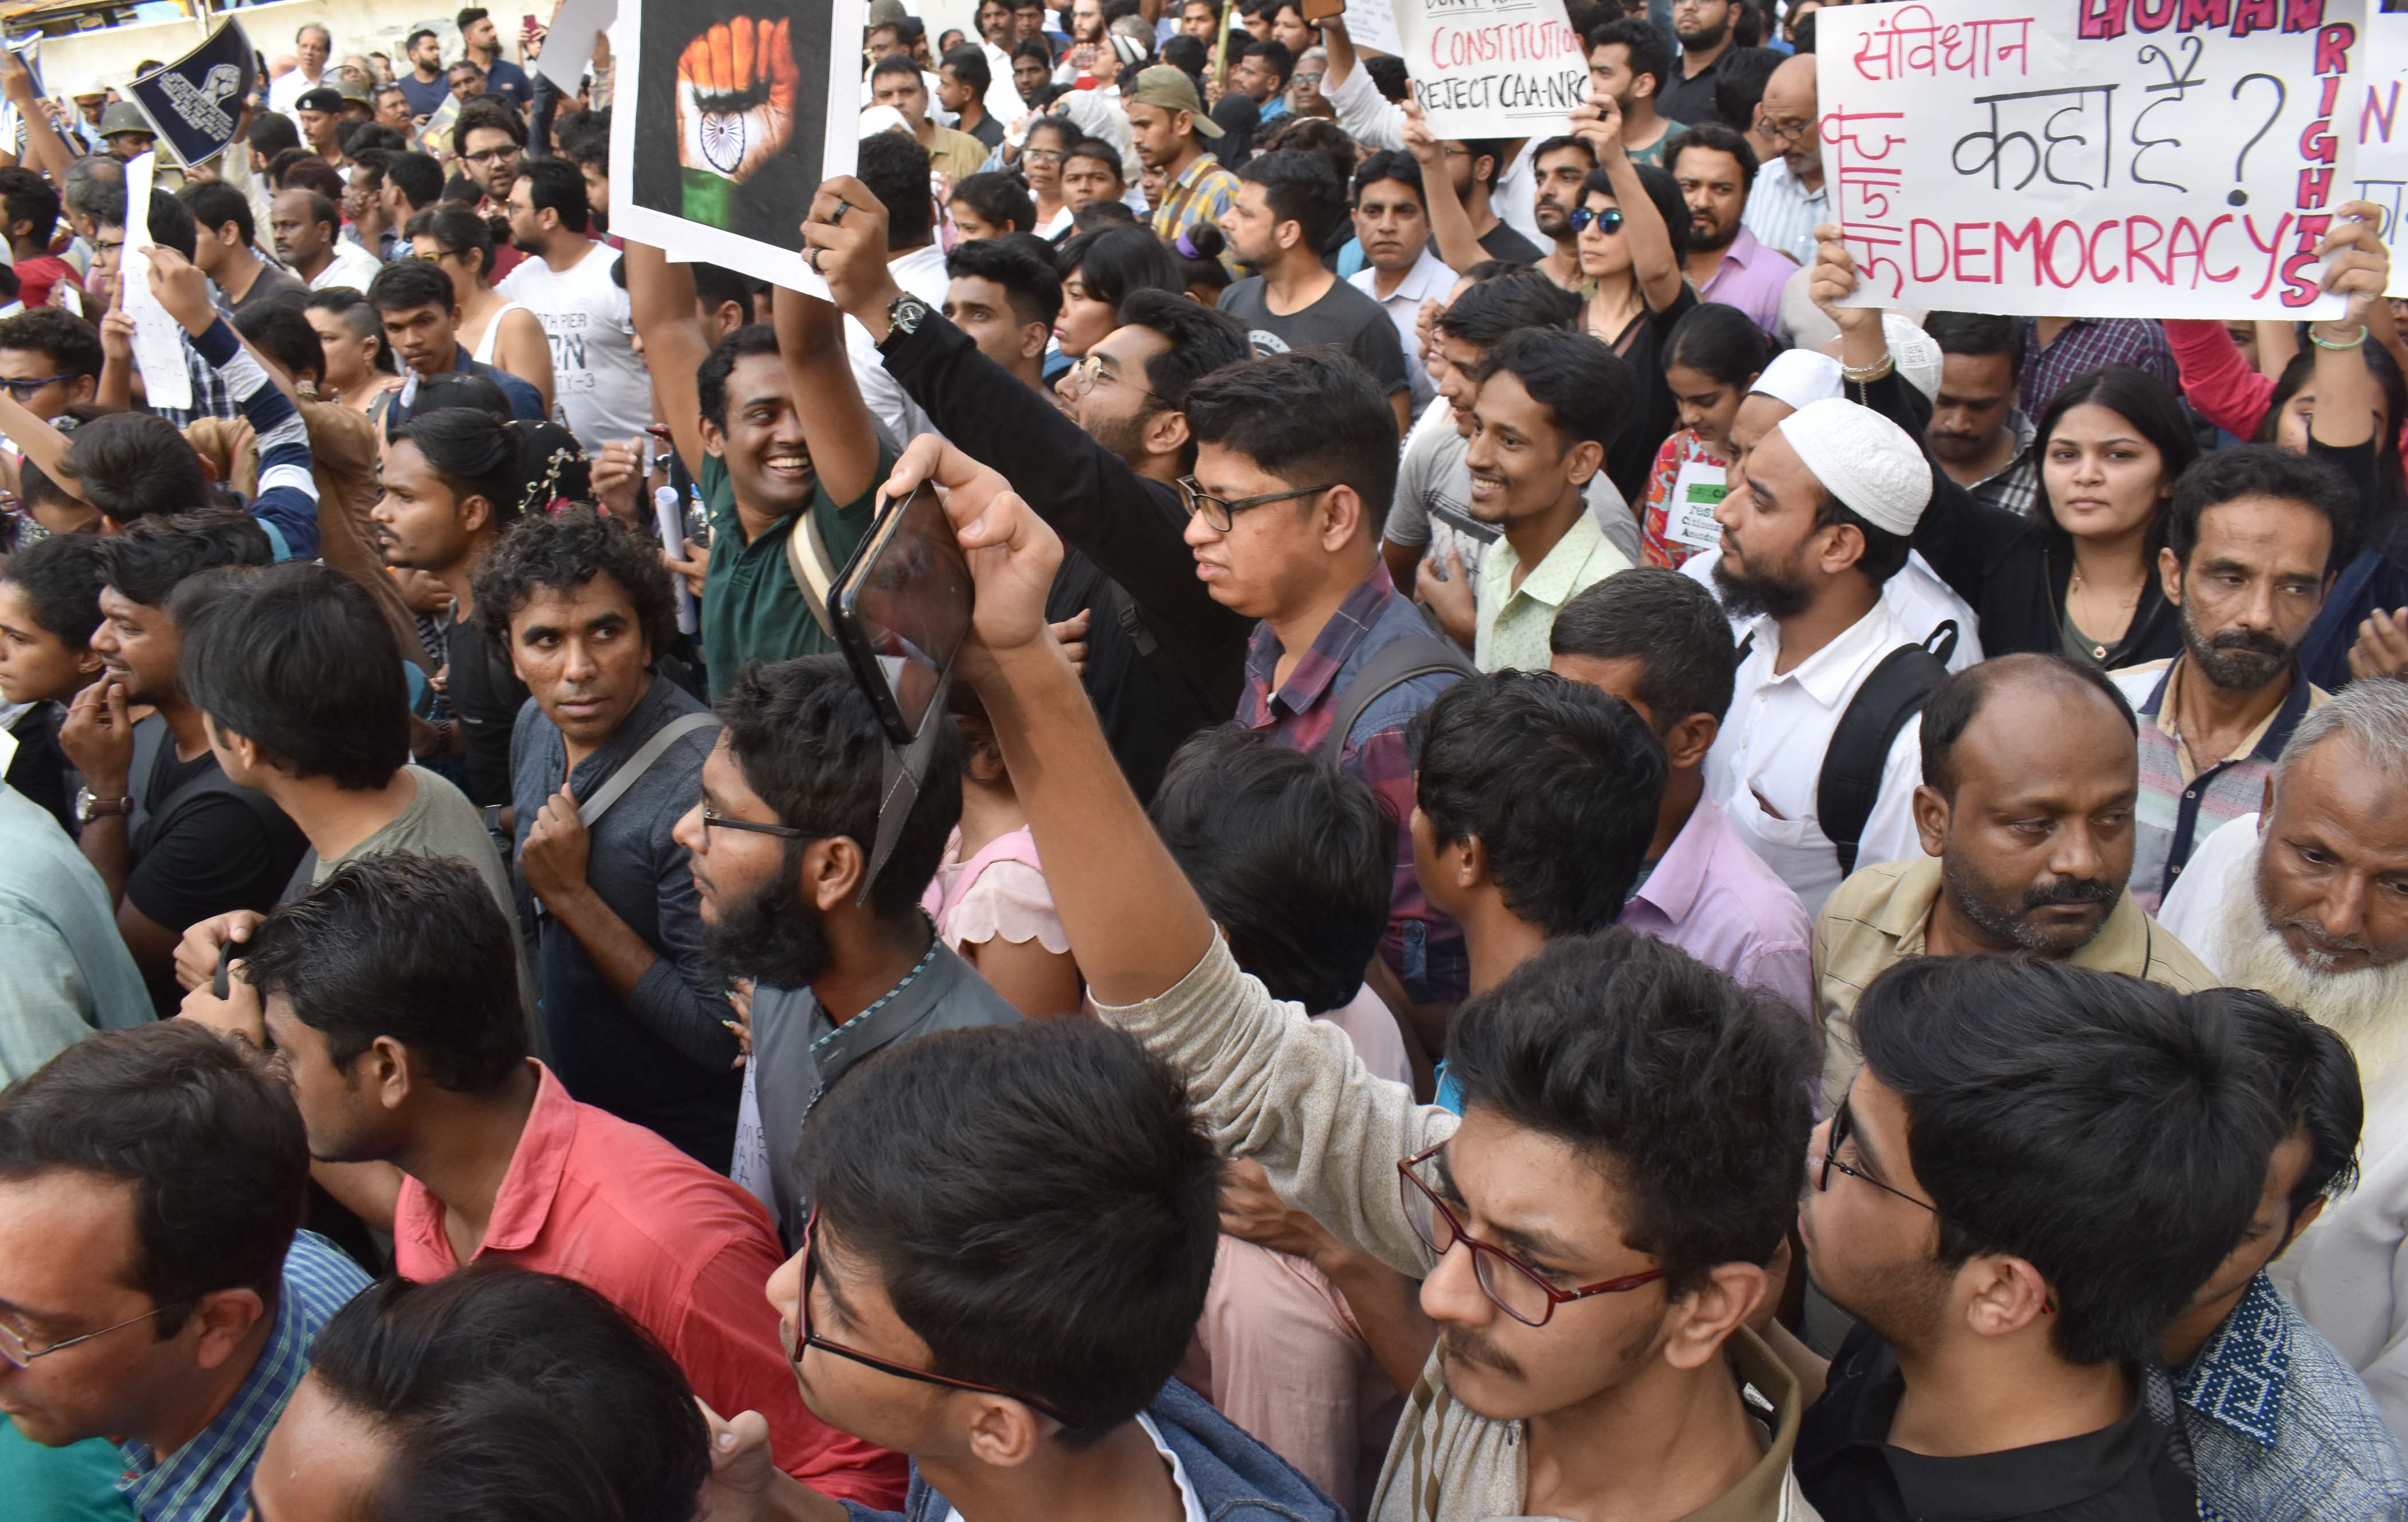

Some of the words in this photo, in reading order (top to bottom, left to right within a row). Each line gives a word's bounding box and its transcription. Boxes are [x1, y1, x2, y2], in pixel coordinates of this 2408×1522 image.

[1431, 21, 1577, 69] CONSTITUTIO
[1854, 5, 2035, 80] संविधान
[2077, 0, 2324, 40] HUMAN
[1414, 75, 1498, 112] REJECT
[1499, 70, 1588, 108] CAA-NRC
[2280, 22, 2356, 308] RIGHTS
[1910, 212, 2294, 300] DEMOCRACY
